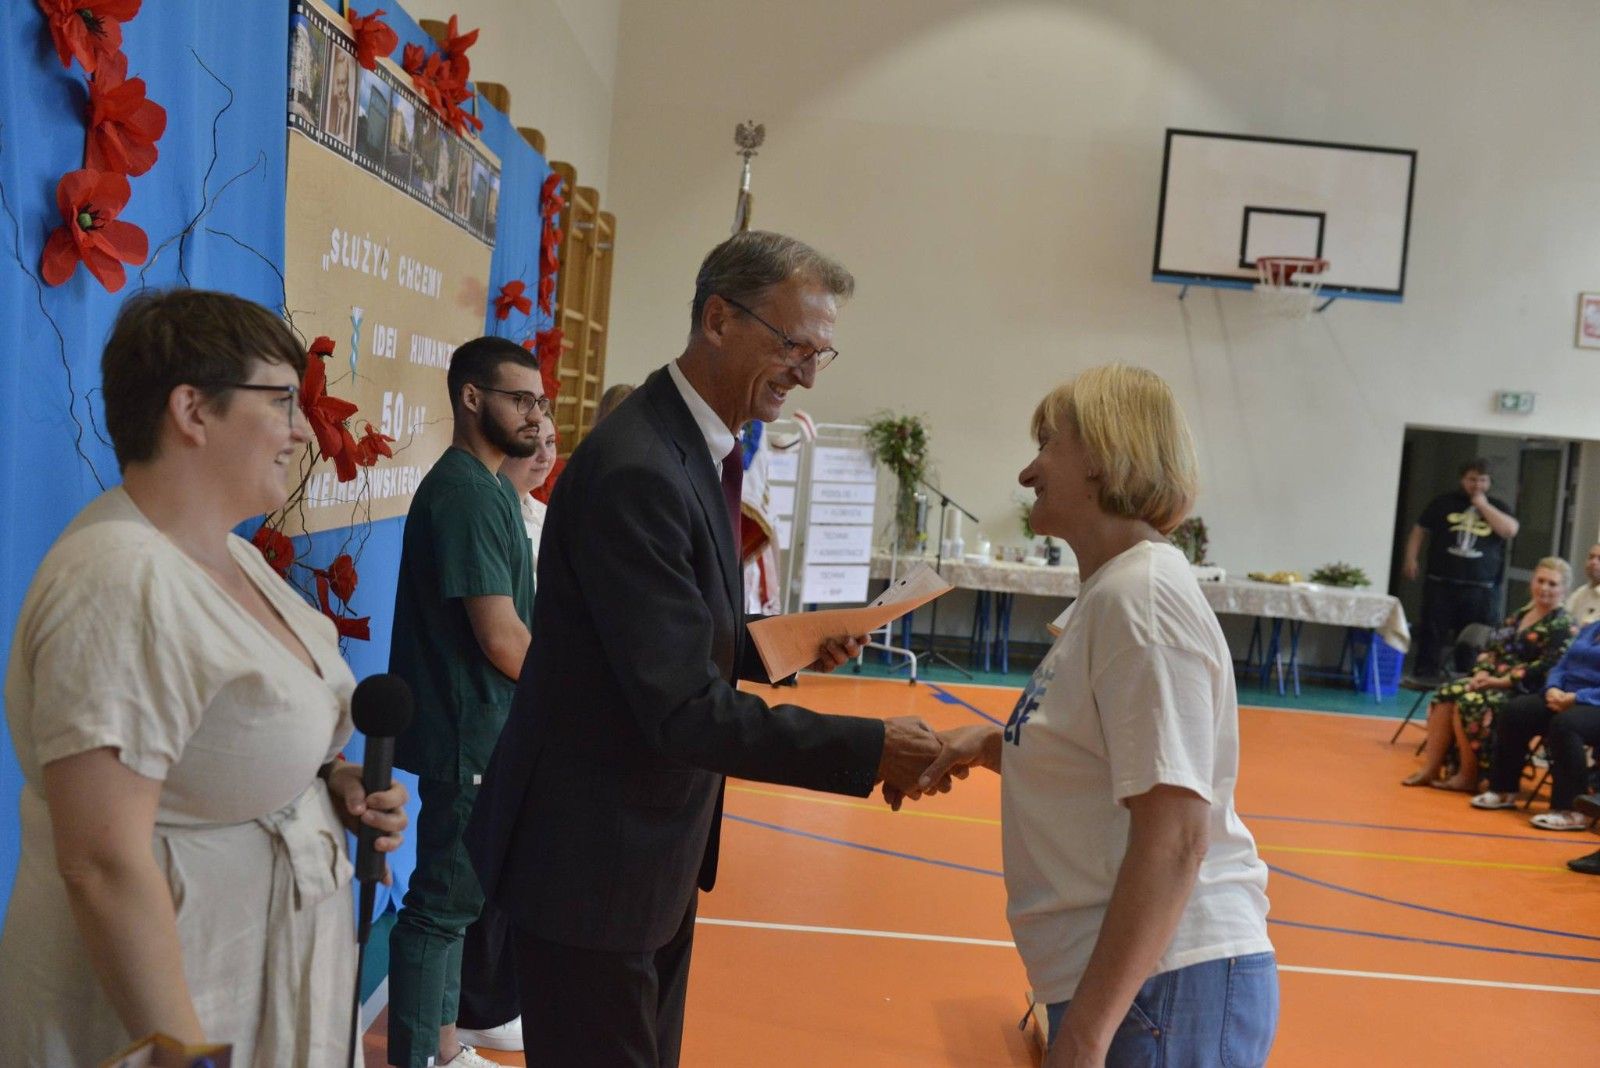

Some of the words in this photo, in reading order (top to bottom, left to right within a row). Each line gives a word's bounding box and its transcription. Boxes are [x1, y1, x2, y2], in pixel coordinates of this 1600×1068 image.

[399, 255, 443, 300] CHCEMY
[373, 323, 397, 359] IDEI
[410, 333, 459, 371] HUMANIZ
[379, 390, 405, 441] 50
